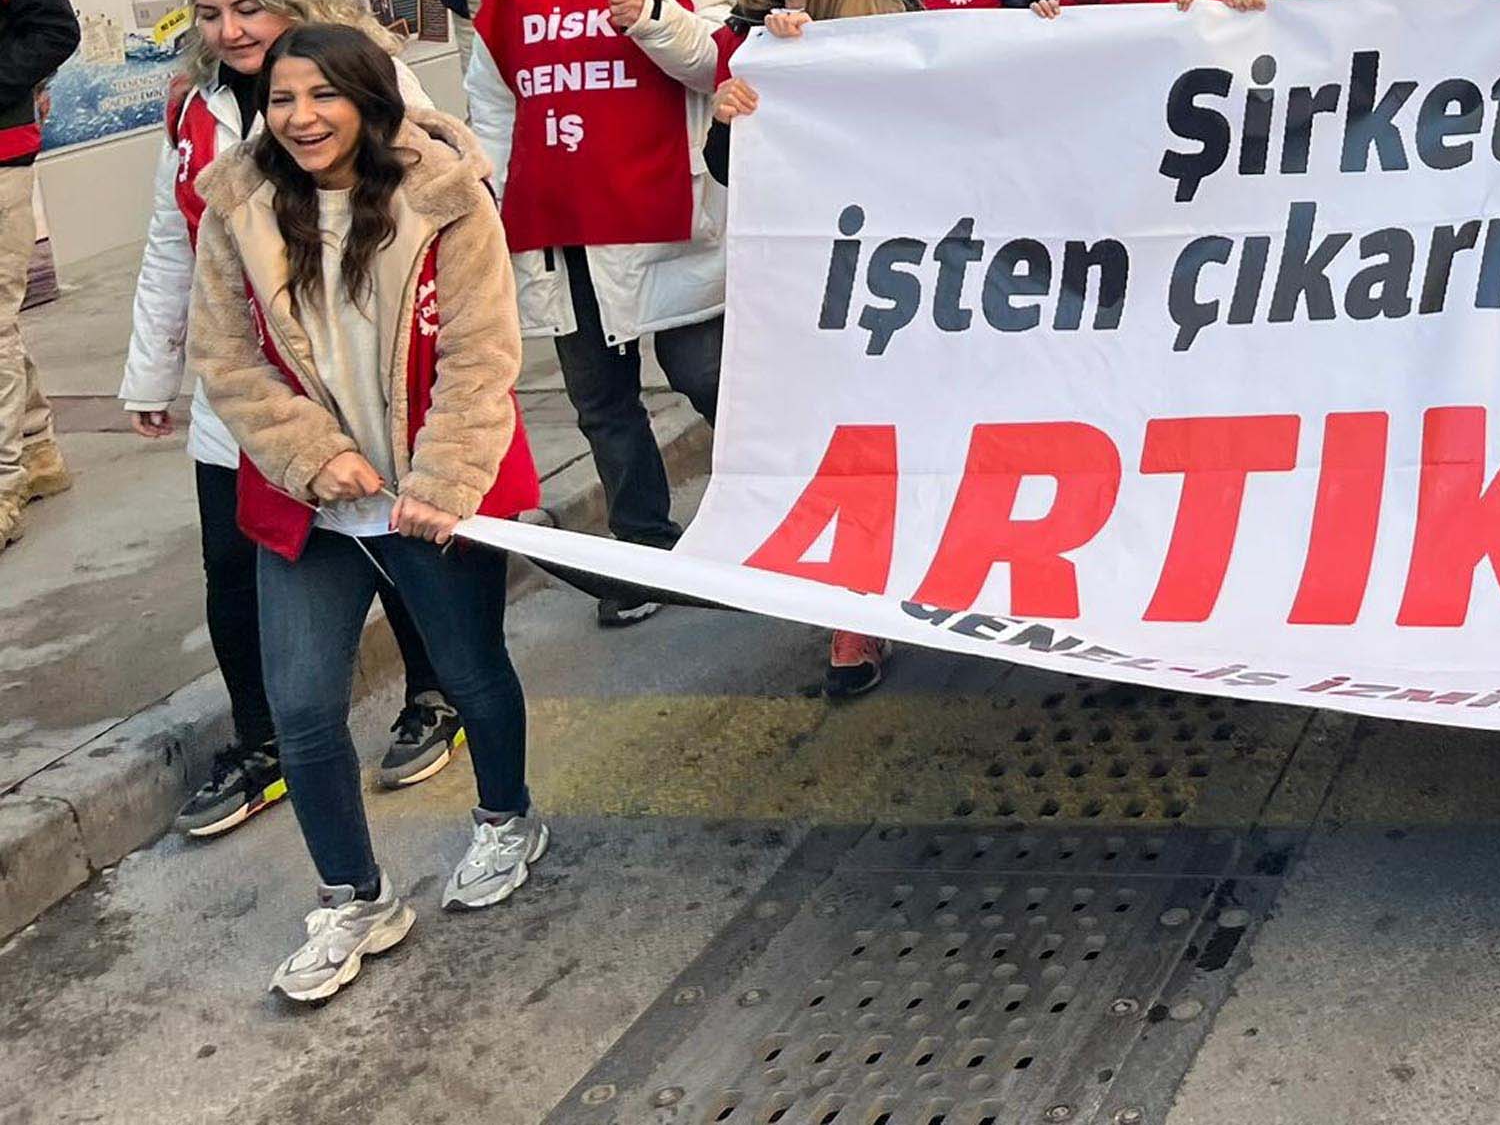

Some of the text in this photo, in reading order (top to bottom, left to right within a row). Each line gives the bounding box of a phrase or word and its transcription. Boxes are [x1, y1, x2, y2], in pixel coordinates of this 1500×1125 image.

[522, 6, 615, 45] DİSK
[515, 61, 638, 99] GENEL
[545, 108, 585, 153] İŞ
[817, 206, 1130, 357] işten
